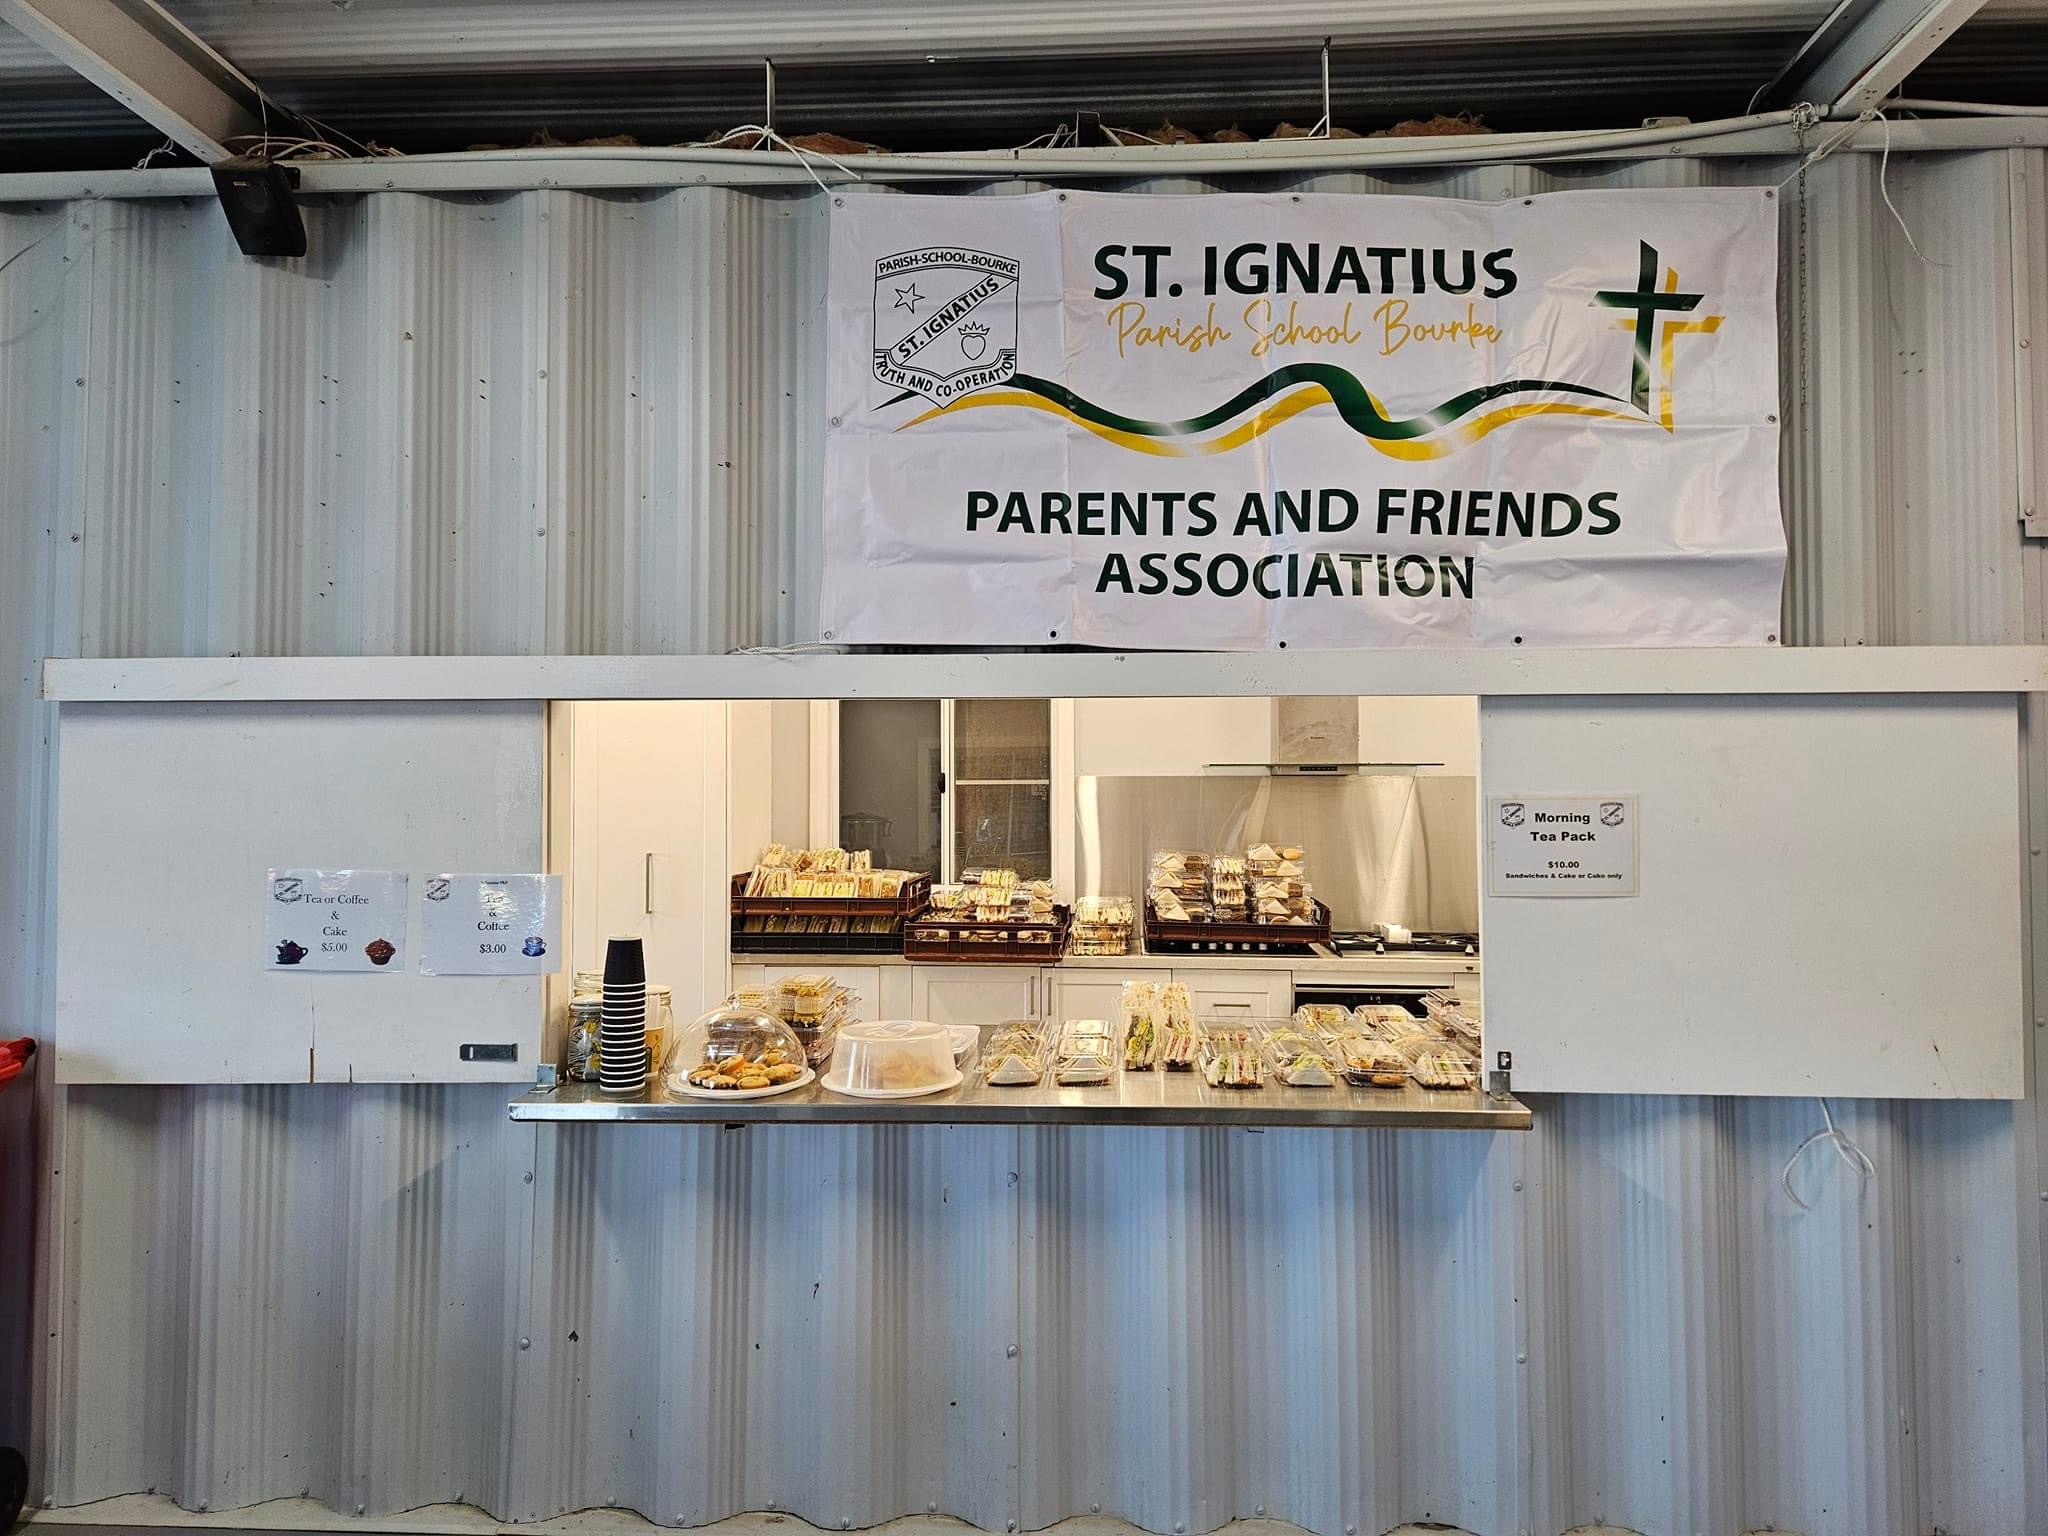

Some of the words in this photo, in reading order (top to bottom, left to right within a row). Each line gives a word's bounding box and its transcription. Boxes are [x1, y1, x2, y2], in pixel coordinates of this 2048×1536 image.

[878, 251, 1017, 275] PARISH-SCHOOL-BOURKE
[1093, 244, 1183, 300] ST.
[1204, 242, 1519, 299] IGNATIUS
[898, 334, 924, 359] ST.
[922, 277, 999, 339] IGNATIUS
[1107, 301, 1231, 359] Parish
[1243, 299, 1361, 358] School
[1372, 298, 1503, 357] Bourke
[875, 353, 906, 385] TRUTH
[908, 378, 933, 393] AND
[935, 353, 1015, 397] CO-OPERATION
[965, 490, 1218, 537] PARENTS
[1232, 489, 1360, 537] AND
[1376, 488, 1622, 539] FRIENDS
[1094, 551, 1475, 600] ASSOCIATION
[1534, 813, 1591, 825] Morning
[1530, 831, 1556, 842] Tea
[1561, 831, 1597, 842] Pack
[1548, 860, 1580, 869] $10.00
[1607, 872, 1623, 880] only
[303, 893, 322, 904] Tea
[324, 896, 335, 904] or
[337, 894, 370, 905] Coffee
[330, 910, 340, 920] &
[322, 926, 347, 936] Cake
[477, 921, 510, 931] Coffee
[320, 942, 348, 953] $5.00
[479, 943, 507, 954] $3.00
